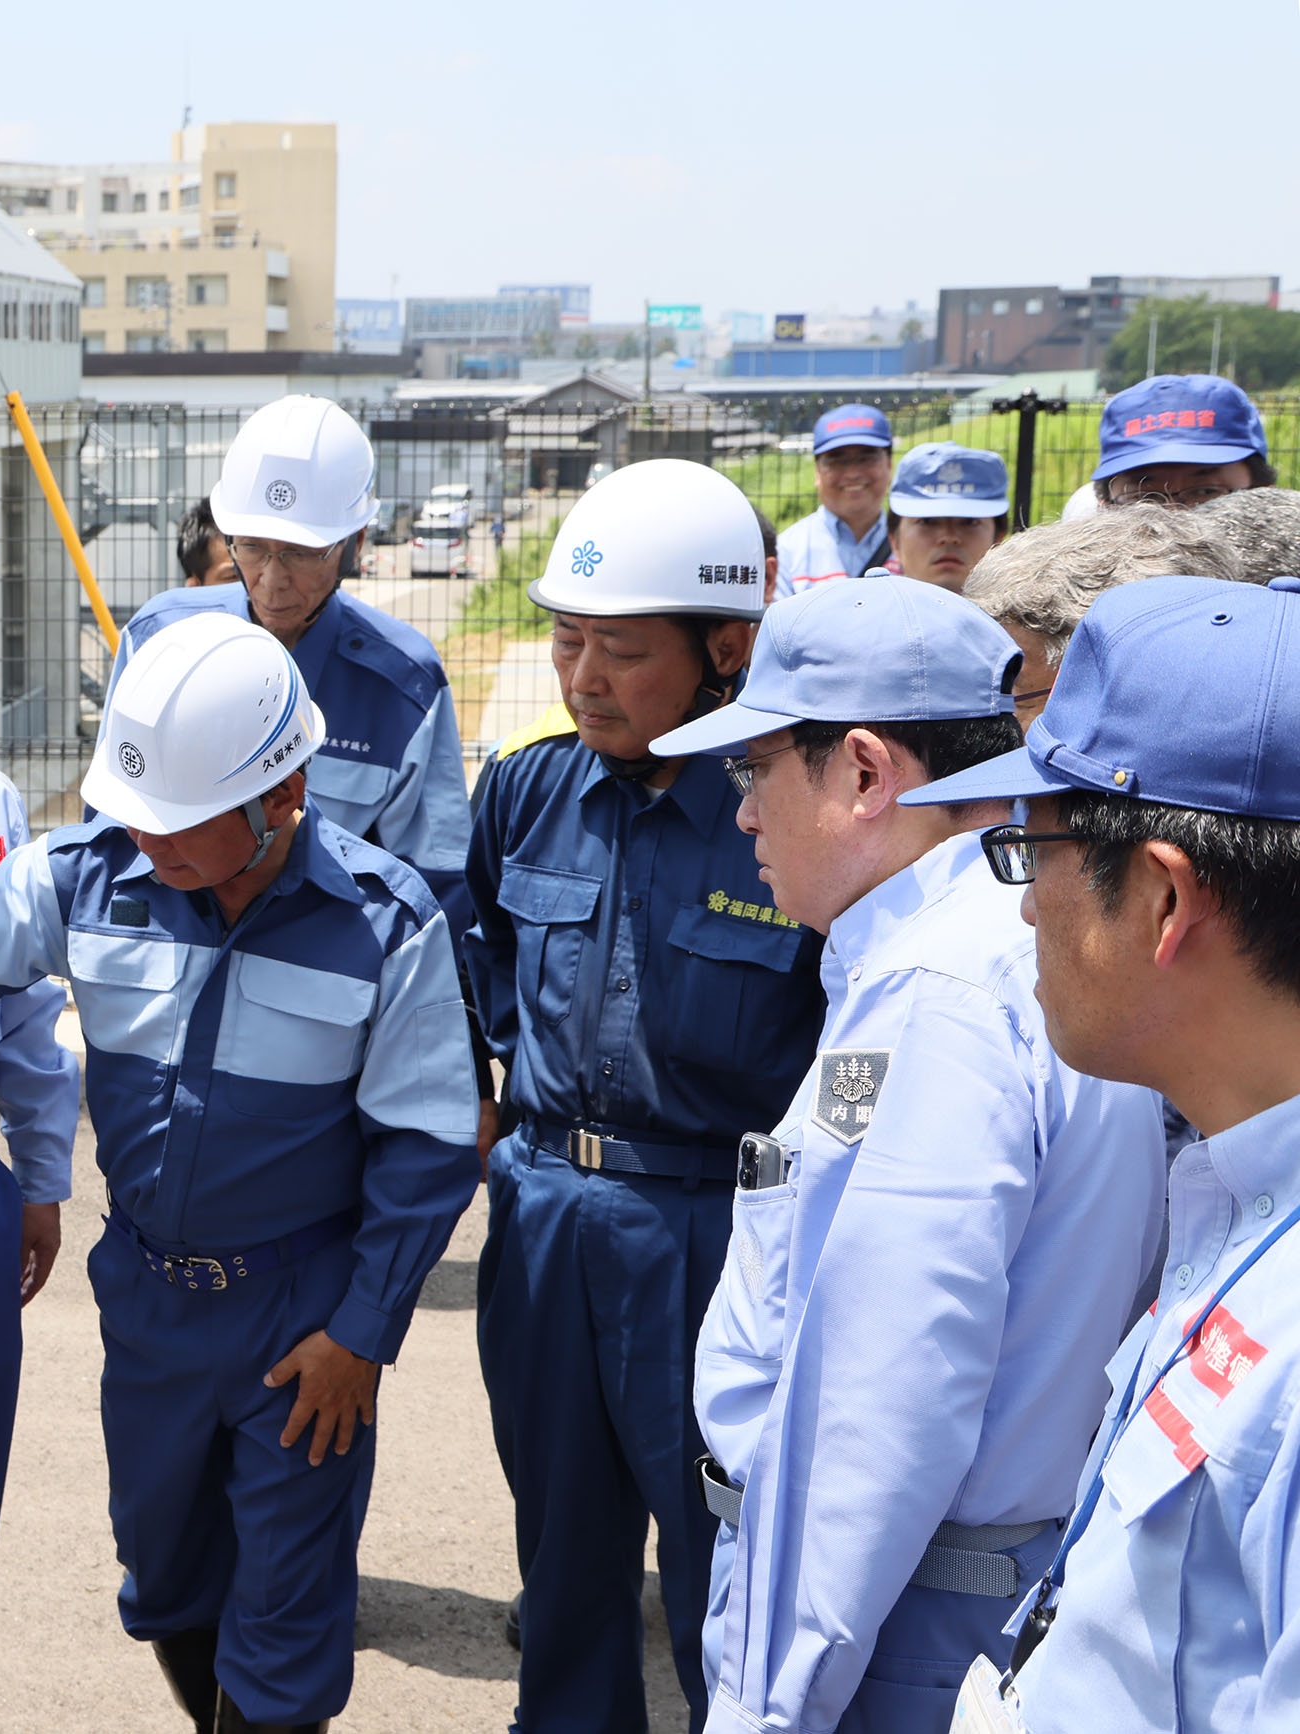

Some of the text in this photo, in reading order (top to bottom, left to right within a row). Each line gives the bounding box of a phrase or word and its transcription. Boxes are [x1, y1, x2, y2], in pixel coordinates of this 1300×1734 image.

[698, 564, 758, 585] 福岡県議会
[262, 732, 302, 773] 久留米市
[831, 1104, 873, 1123] 内閣
